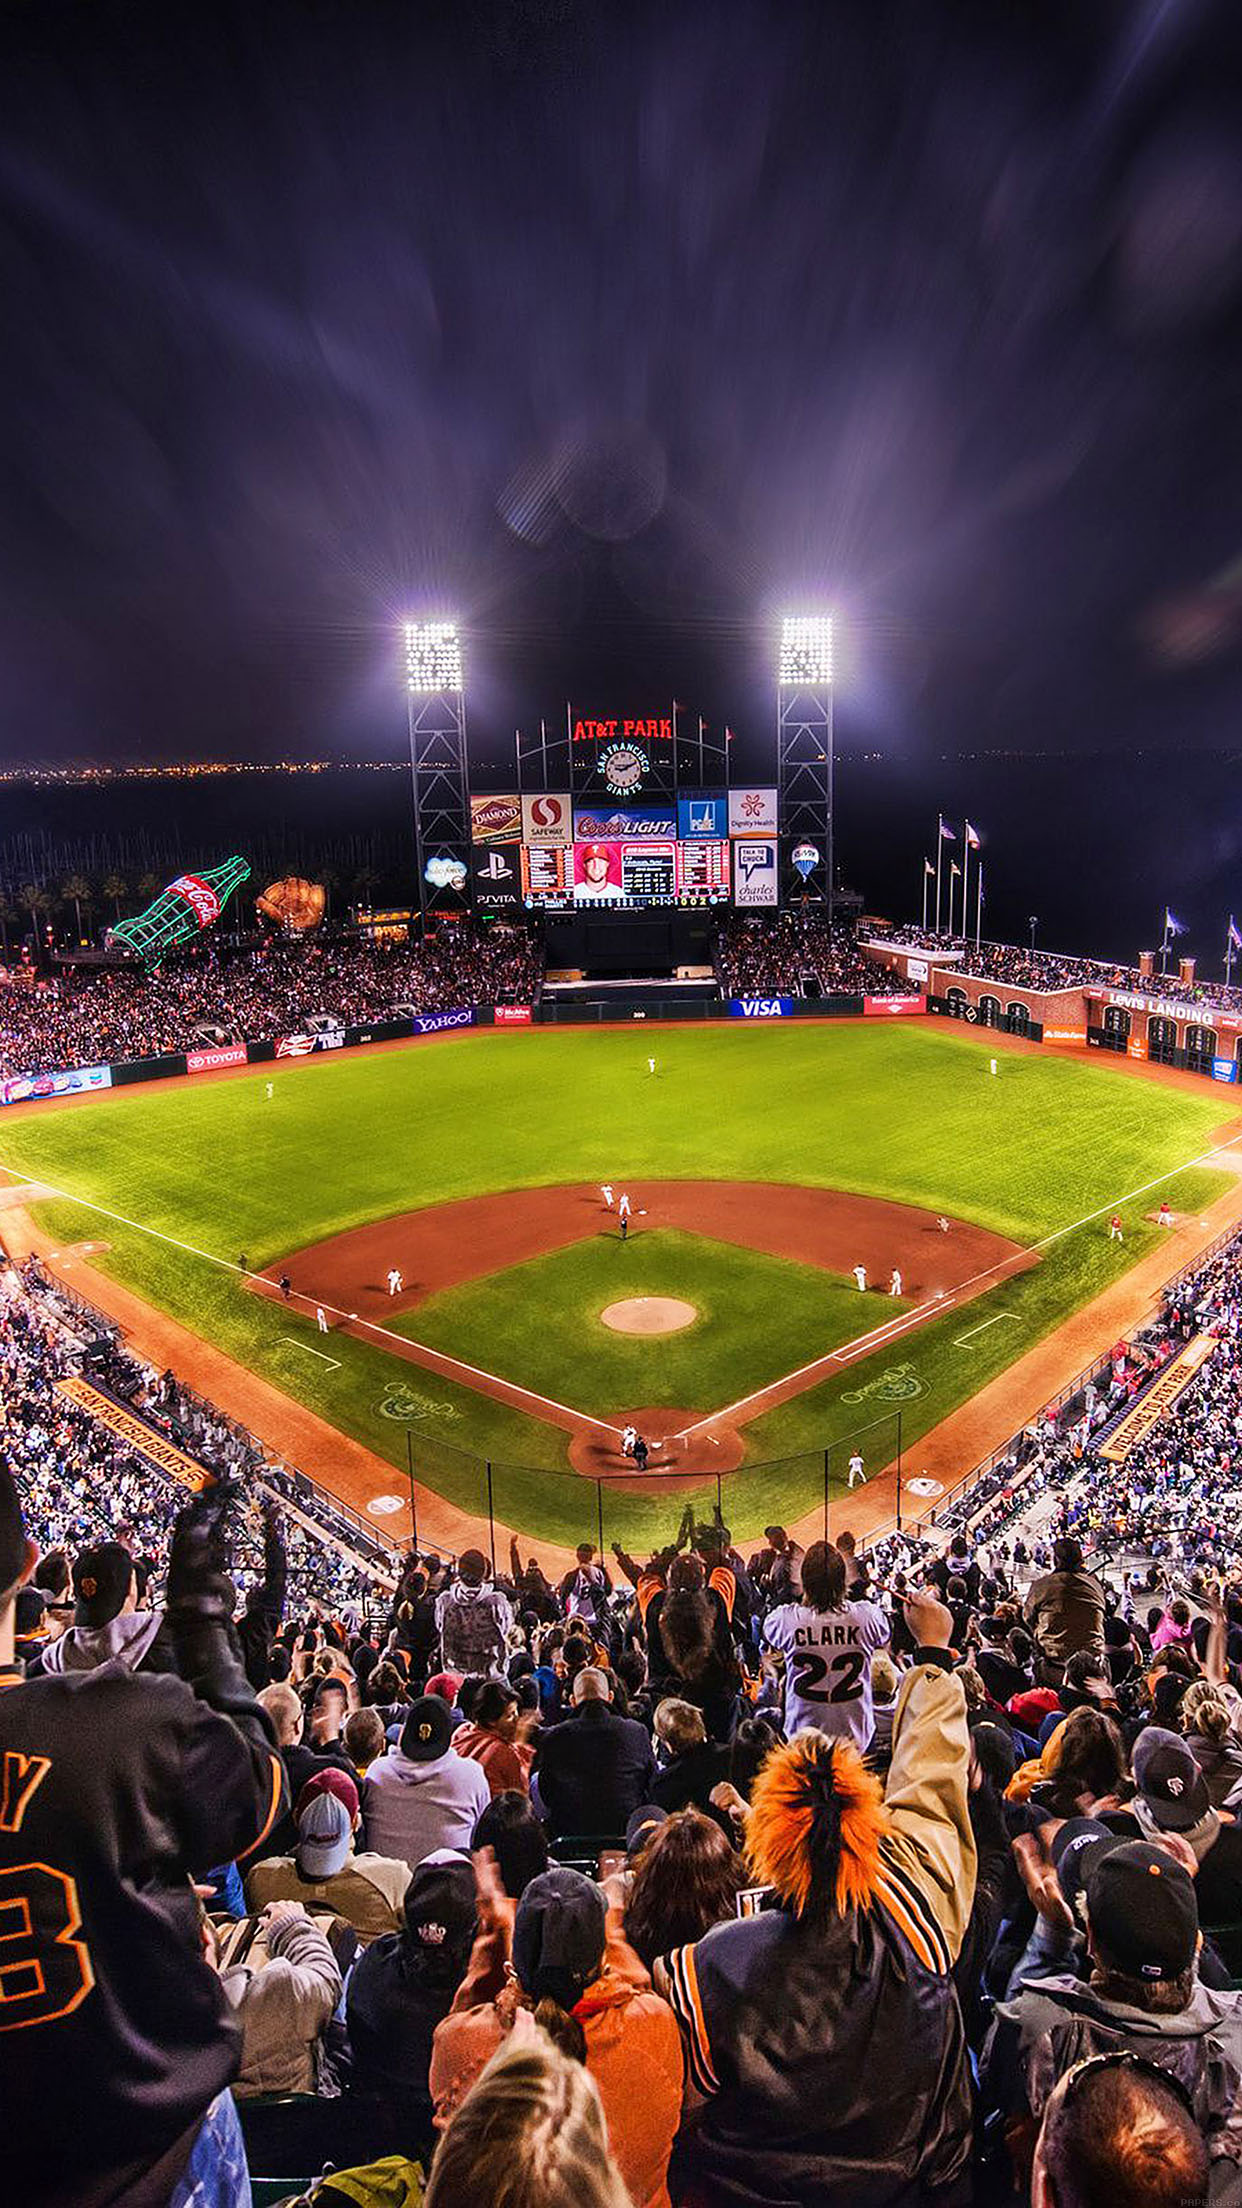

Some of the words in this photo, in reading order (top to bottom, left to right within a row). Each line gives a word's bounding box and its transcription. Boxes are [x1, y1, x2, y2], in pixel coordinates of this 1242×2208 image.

[573, 720, 617, 741] AT&T
[623, 720, 672, 739] PARK
[597, 752, 609, 774] SAN
[607, 742, 650, 773] FRANCISCO
[606, 782, 642, 796] GIANTS
[475, 807, 518, 825] DIAMOND
[578, 816, 623, 836] Coors
[623, 820, 672, 834] LIGHT
[531, 828, 564, 836] SAFEWAY
[739, 1001, 782, 1016] VISA
[1148, 1001, 1214, 1026] LANDING
[416, 1010, 472, 1032] YAHOO!
[204, 1050, 247, 1065] TOYOTA
[75, 1389, 103, 1411] SAN
[98, 1404, 151, 1445] FRANCISCO
[143, 1440, 192, 1476] GIANTS
[1108, 1412, 1153, 1453] WELCOME
[1142, 1401, 1162, 1413] TO
[795, 1625, 861, 1647] CLARK
[791, 1651, 866, 1705] 22
